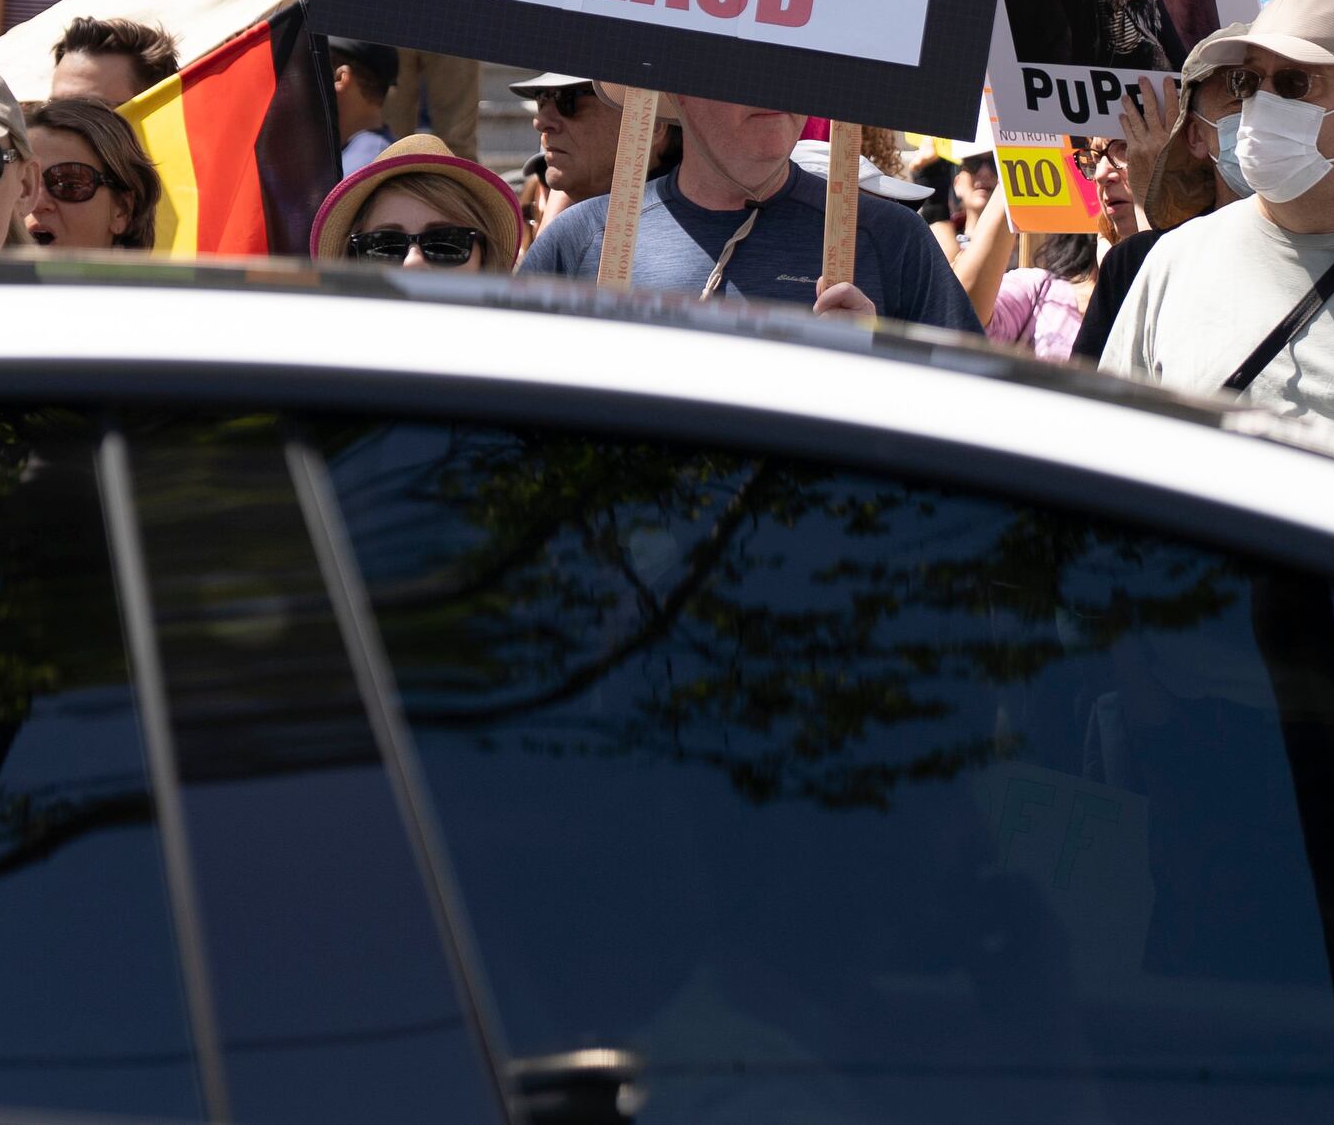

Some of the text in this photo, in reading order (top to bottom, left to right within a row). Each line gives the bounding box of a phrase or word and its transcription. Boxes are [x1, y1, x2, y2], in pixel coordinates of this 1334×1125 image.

[999, 130, 1057, 142] NO TRUTH
[1002, 158, 1062, 198] no
